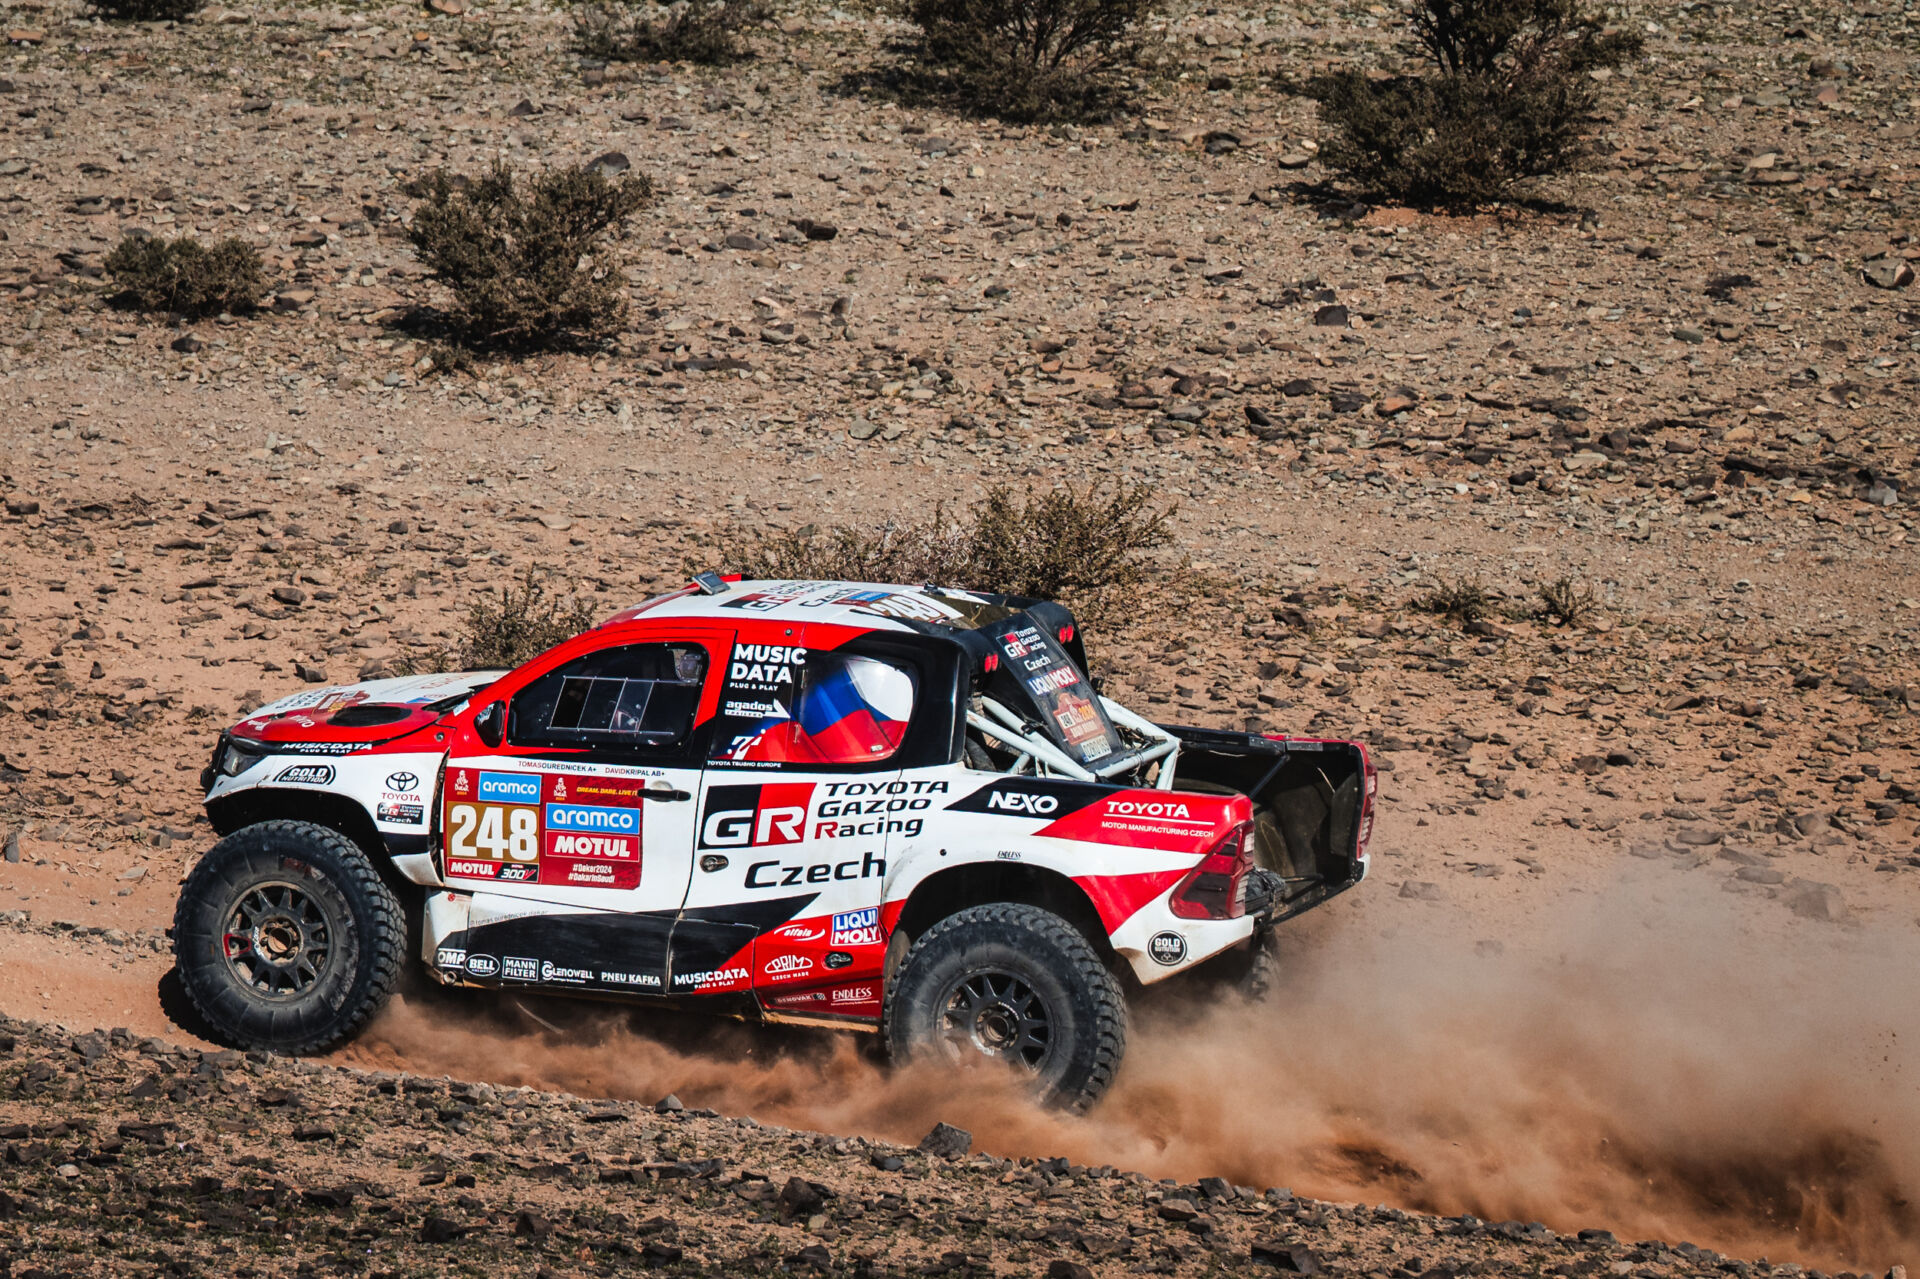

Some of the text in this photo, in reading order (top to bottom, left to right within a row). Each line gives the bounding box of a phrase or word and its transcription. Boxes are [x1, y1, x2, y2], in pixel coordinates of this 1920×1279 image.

[734, 643, 807, 665] MUSIC
[1004, 641, 1028, 657] GR
[1023, 654, 1051, 671] Czech
[730, 663, 792, 683] DATA
[730, 682, 749, 690] PLUG
[726, 700, 773, 711] agados
[281, 775, 327, 784] NUTRITION
[289, 766, 327, 777] GOLD
[482, 781, 537, 795] aramco
[824, 781, 949, 797] TOYOTA
[381, 792, 421, 802] TOYOTA
[987, 790, 1058, 814] NEXO
[817, 799, 932, 818] GAZOO
[1107, 801, 1190, 818] TOYOTA
[552, 808, 633, 829] aramco
[703, 806, 805, 846] GR
[451, 804, 538, 861] 248
[814, 817, 924, 840] Racing
[1101, 821, 1214, 838] MOTOR MANUFACTURING CZECH
[554, 835, 631, 858] MOTUL
[997, 850, 1022, 858] ENDLESS
[451, 861, 495, 876] MOTUL
[501, 868, 536, 879] 300V
[572, 864, 612, 874] #Dakar2024
[744, 851, 887, 889] Czech
[835, 909, 876, 932] LIQUI
[834, 927, 879, 944] MOLY
[1155, 937, 1180, 947] GOLD
[437, 951, 465, 965] OMP
[469, 958, 495, 970] BELL
[505, 959, 536, 969] MANN
[771, 954, 804, 971] PRIM
[504, 968, 536, 978] FILTER
[601, 972, 662, 985] PNEU KAFKA
[674, 967, 749, 986] MUSICDATA
[832, 987, 872, 1000] ENDLESS
